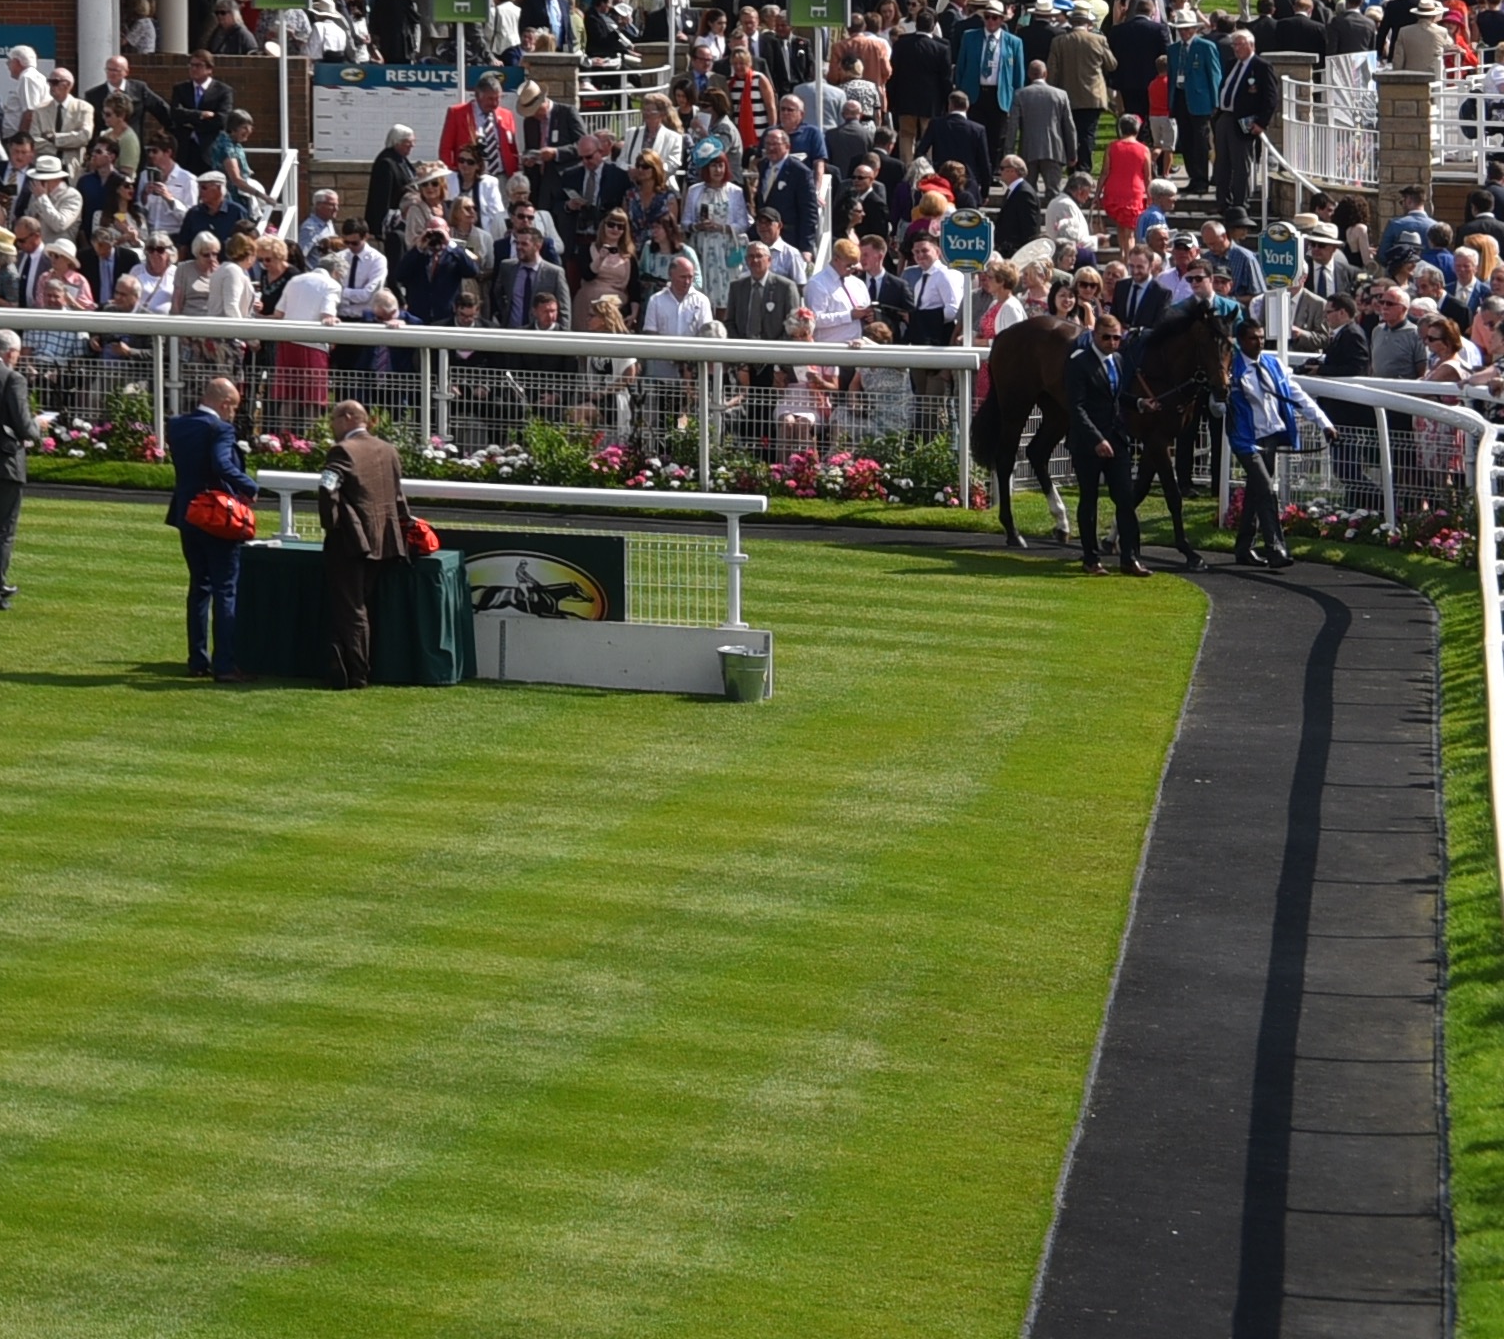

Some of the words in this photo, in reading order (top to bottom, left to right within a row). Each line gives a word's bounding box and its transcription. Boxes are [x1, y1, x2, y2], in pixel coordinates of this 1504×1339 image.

[385, 69, 460, 83] RESULTS
[946, 234, 986, 252] York
[1263, 246, 1295, 266] York
